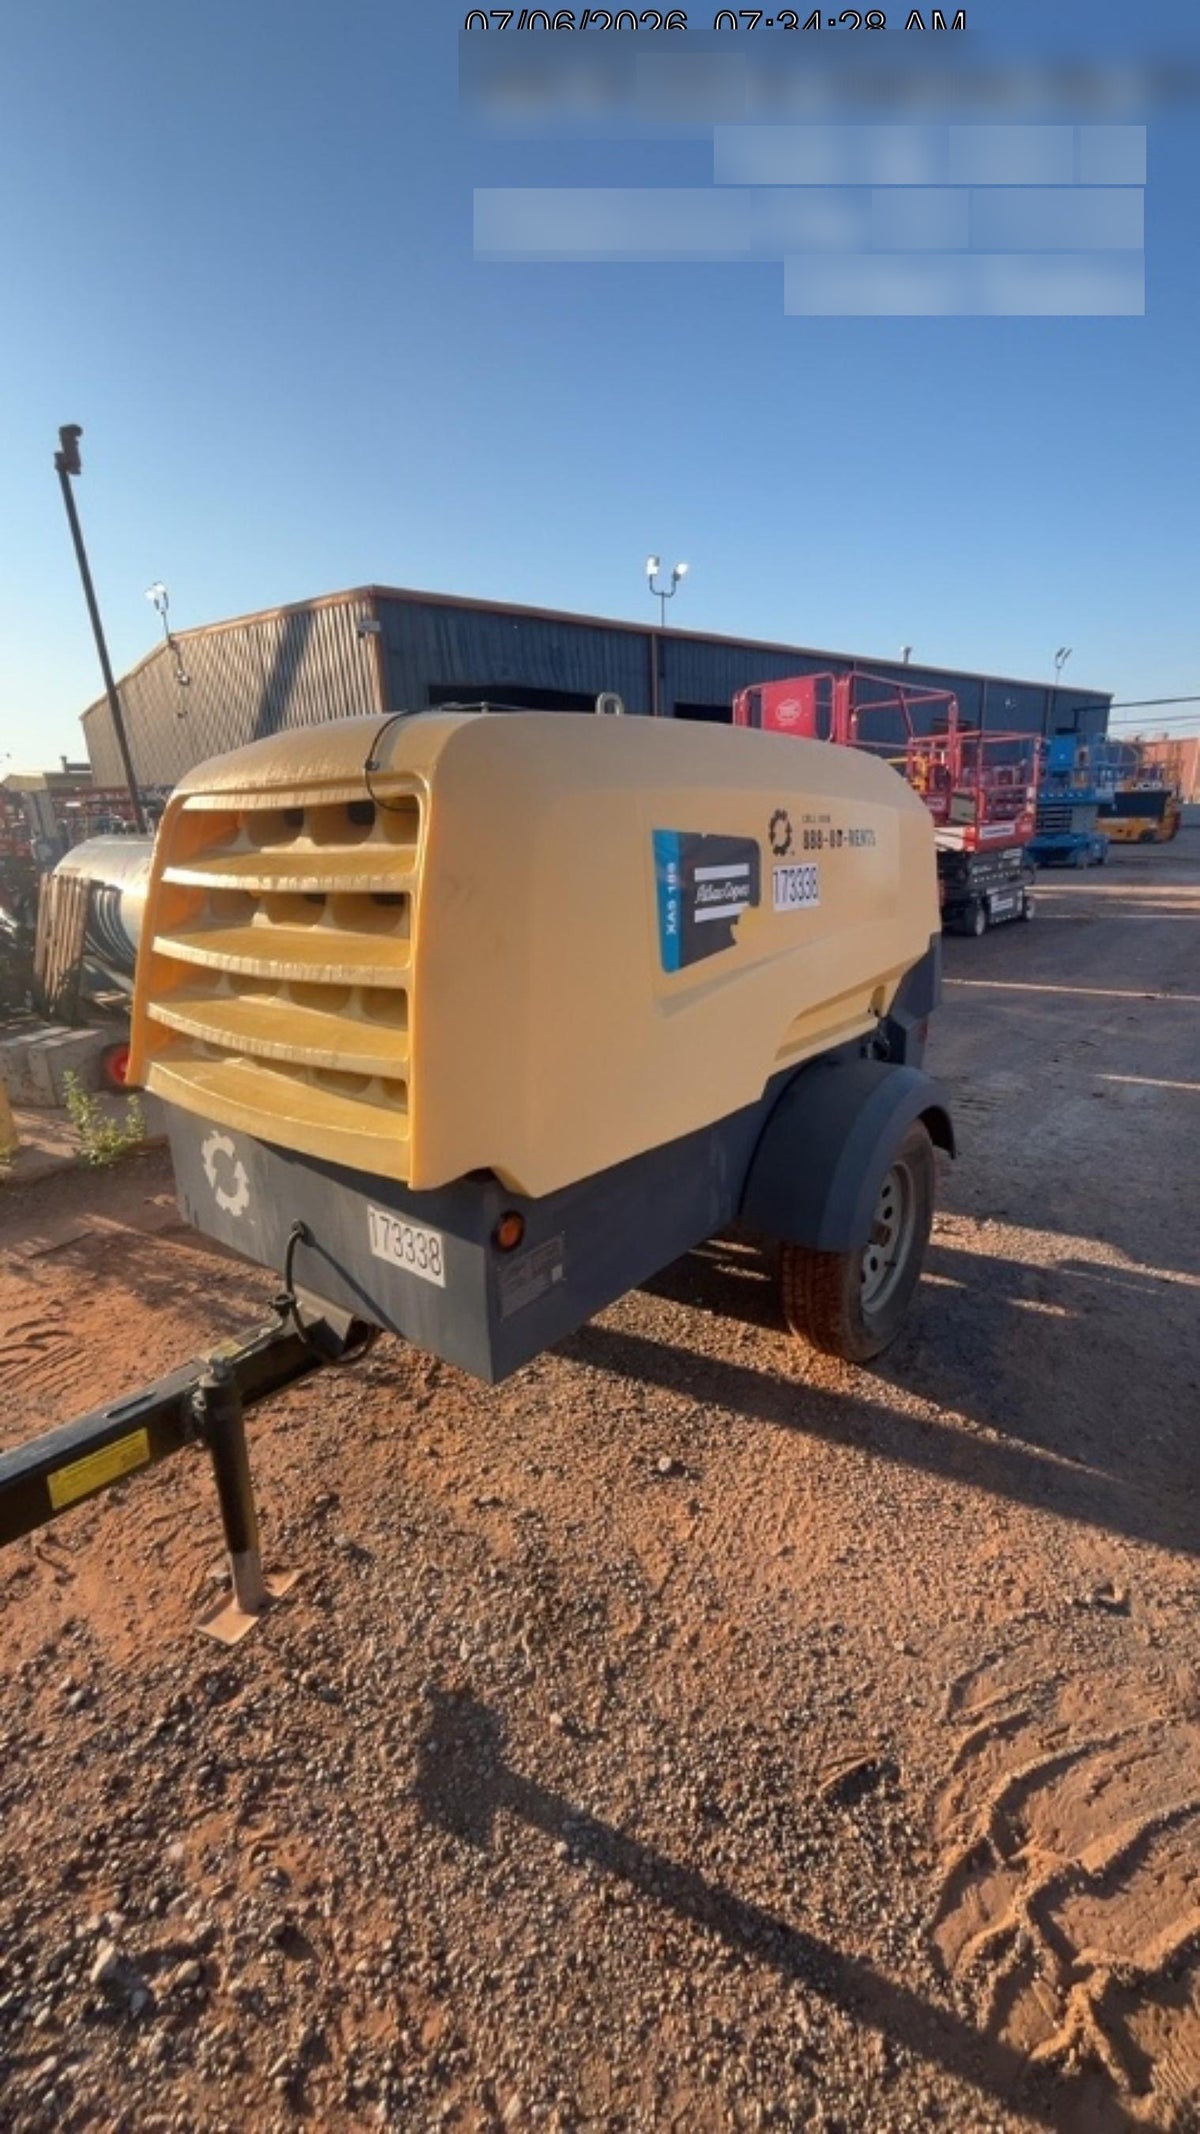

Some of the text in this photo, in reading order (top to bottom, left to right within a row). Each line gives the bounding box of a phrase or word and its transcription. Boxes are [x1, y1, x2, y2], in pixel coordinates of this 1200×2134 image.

[772, 867, 818, 904] 173338
[666, 900, 677, 935] XAS
[370, 1212, 443, 1277] 173338
